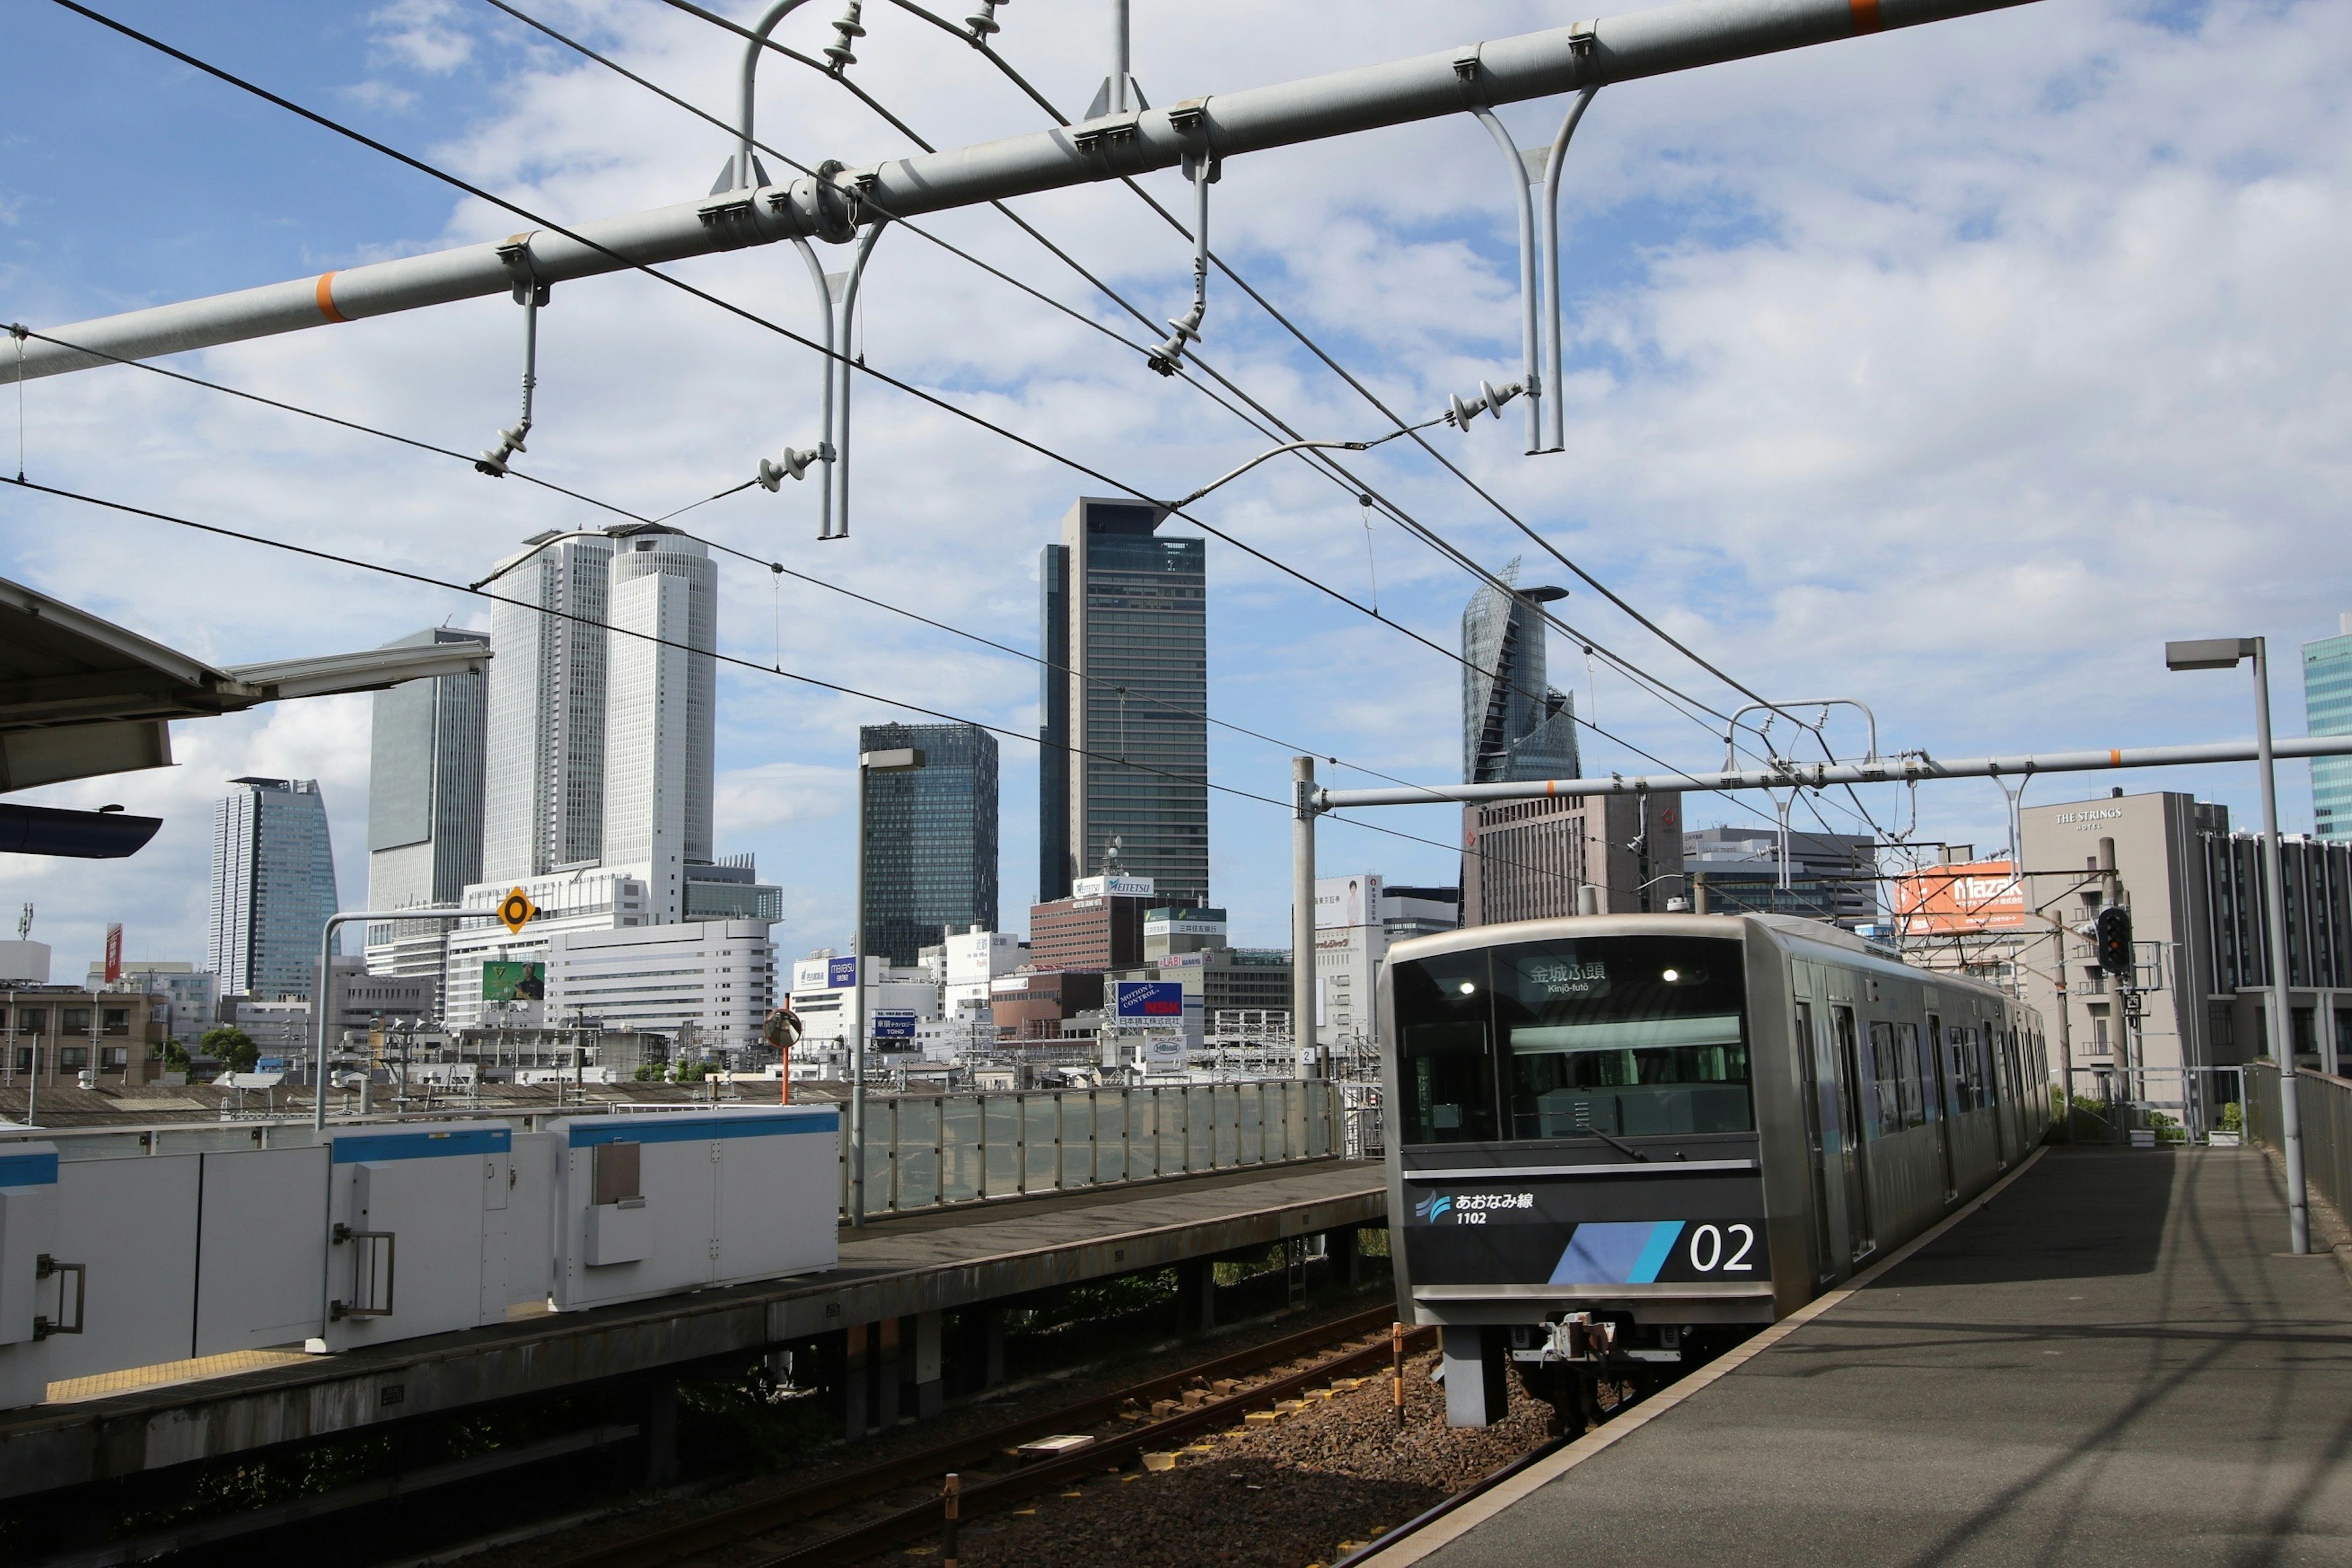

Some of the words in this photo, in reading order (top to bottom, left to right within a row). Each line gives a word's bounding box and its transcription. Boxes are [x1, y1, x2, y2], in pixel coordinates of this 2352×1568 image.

[2056, 813, 2076, 824] THE
[2078, 808, 2122, 822] STRINGS
[1077, 881, 1100, 894] MEITETSU
[1107, 878, 1150, 892] MEITETSU
[1953, 876, 2022, 900] Mazak
[992, 937, 1007, 946] 近鉄
[1164, 956, 1181, 966] LABI
[1531, 962, 1605, 983] 金城ふ頭
[1120, 985, 1148, 1003] MOTION
[1548, 982, 1589, 993] Kinjō-futō
[1123, 990, 1156, 1008] CONTROL
[1145, 1001, 1181, 1014] NSK
[1305, 1051, 1310, 1060] 2
[1456, 1193, 1534, 1209] あおなみ線
[1457, 1212, 1487, 1224] 1102
[1690, 1224, 1754, 1272] 02
